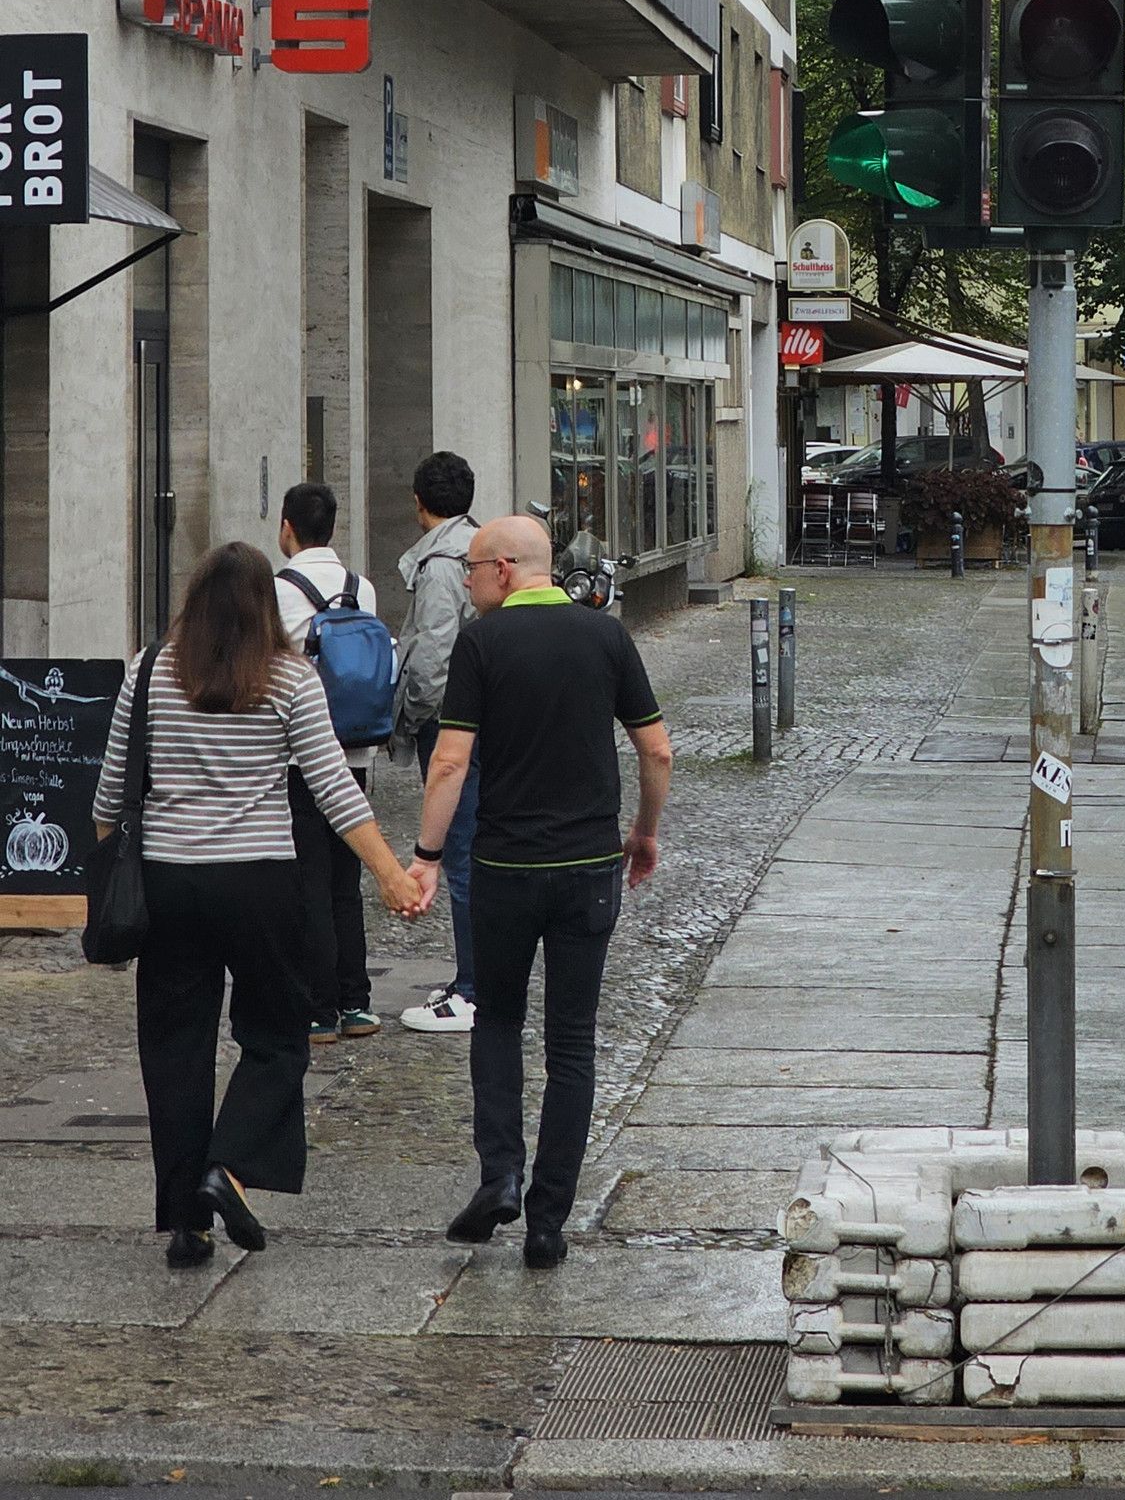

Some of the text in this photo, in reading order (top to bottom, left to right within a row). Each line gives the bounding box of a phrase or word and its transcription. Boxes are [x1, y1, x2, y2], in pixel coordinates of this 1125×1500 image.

[23, 70, 63, 206] BROT
[792, 262, 834, 272] Schultheiss
[784, 328, 820, 361] illy
[1, 712, 76, 731] Neu im Herbst
[22, 791, 45, 807] vegan
